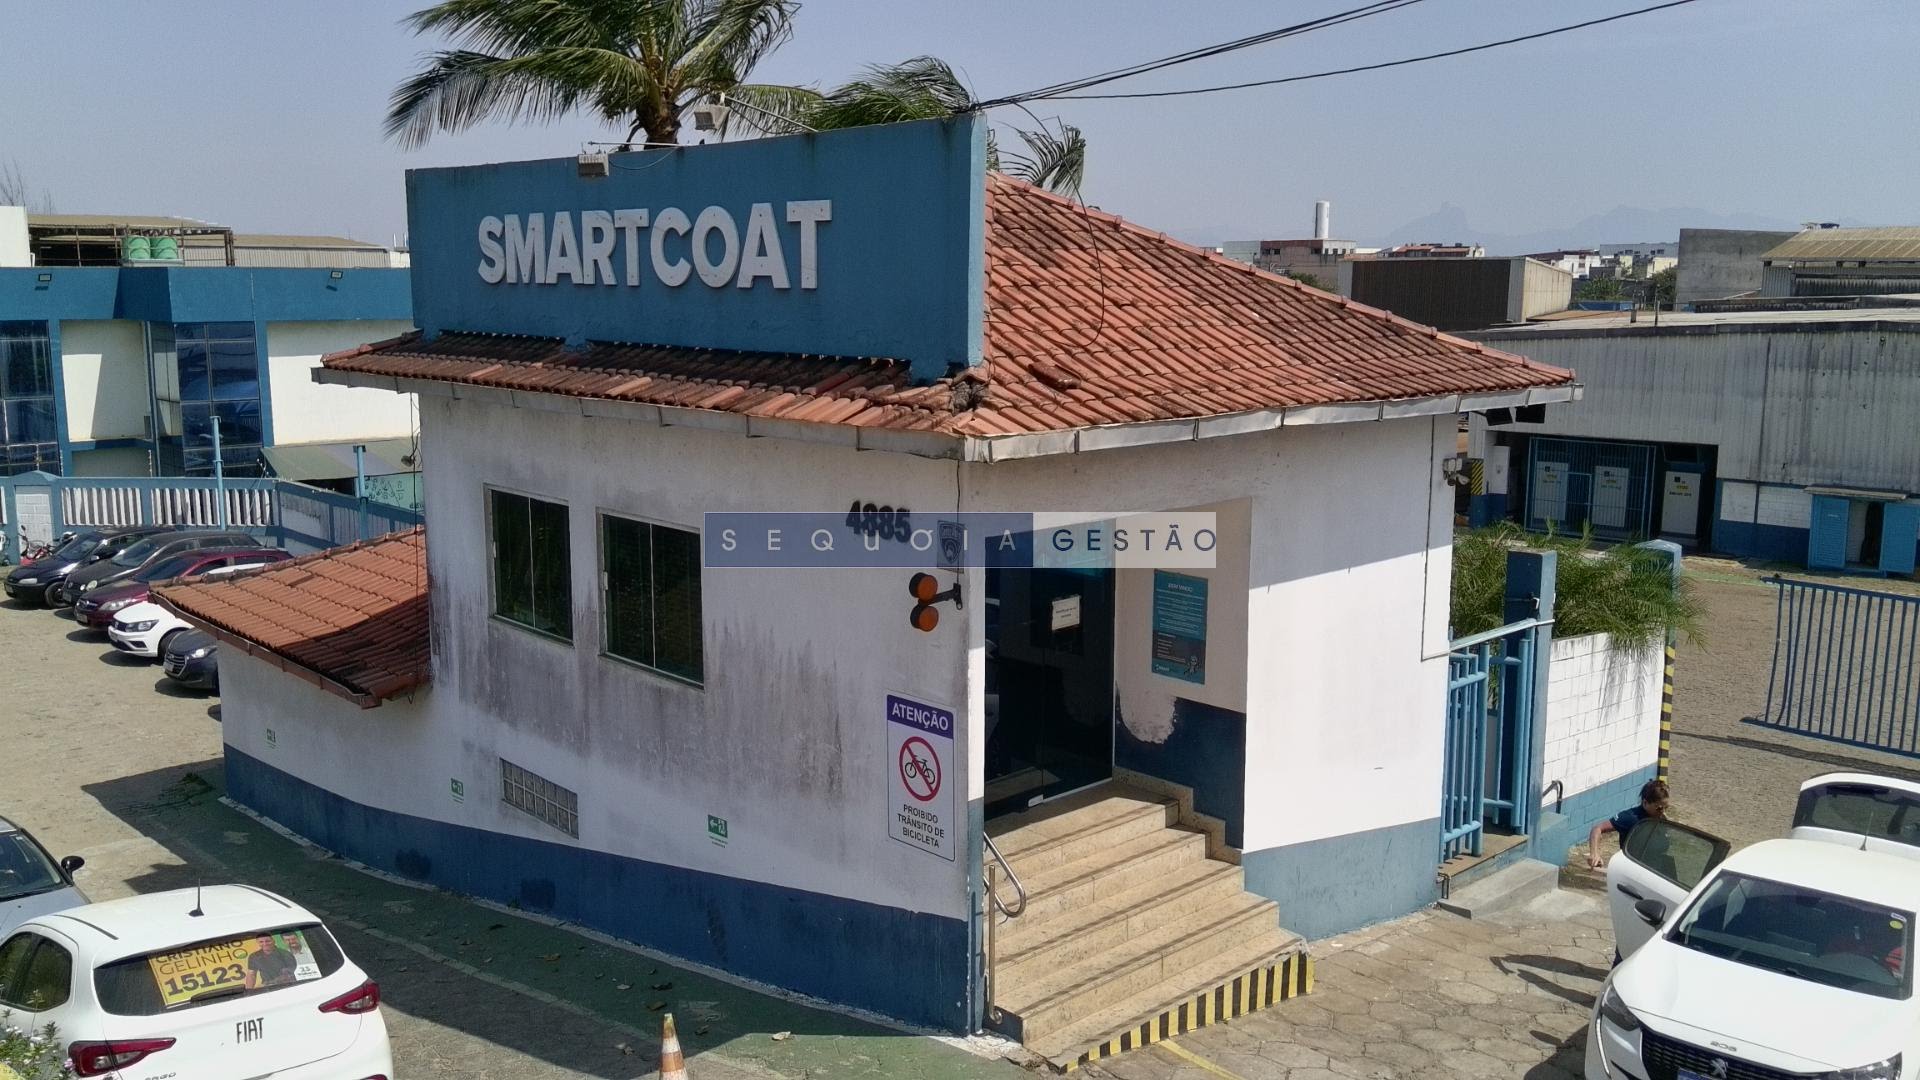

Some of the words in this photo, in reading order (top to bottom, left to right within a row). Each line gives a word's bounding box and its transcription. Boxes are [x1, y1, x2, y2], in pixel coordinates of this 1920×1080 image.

[477, 199, 833, 289] SMARTCOAT
[846, 500, 911, 543] 4885
[892, 702, 949, 731] ATENÇÃO
[897, 813, 934, 834] TRÂNSITO
[934, 827, 945, 838] DE
[903, 804, 939, 824] PROIBIDO
[902, 827, 940, 848] BICICLETA
[159, 948, 249, 975] GELINHO
[164, 963, 247, 997] 15123
[236, 1017, 265, 1044] FIAT
